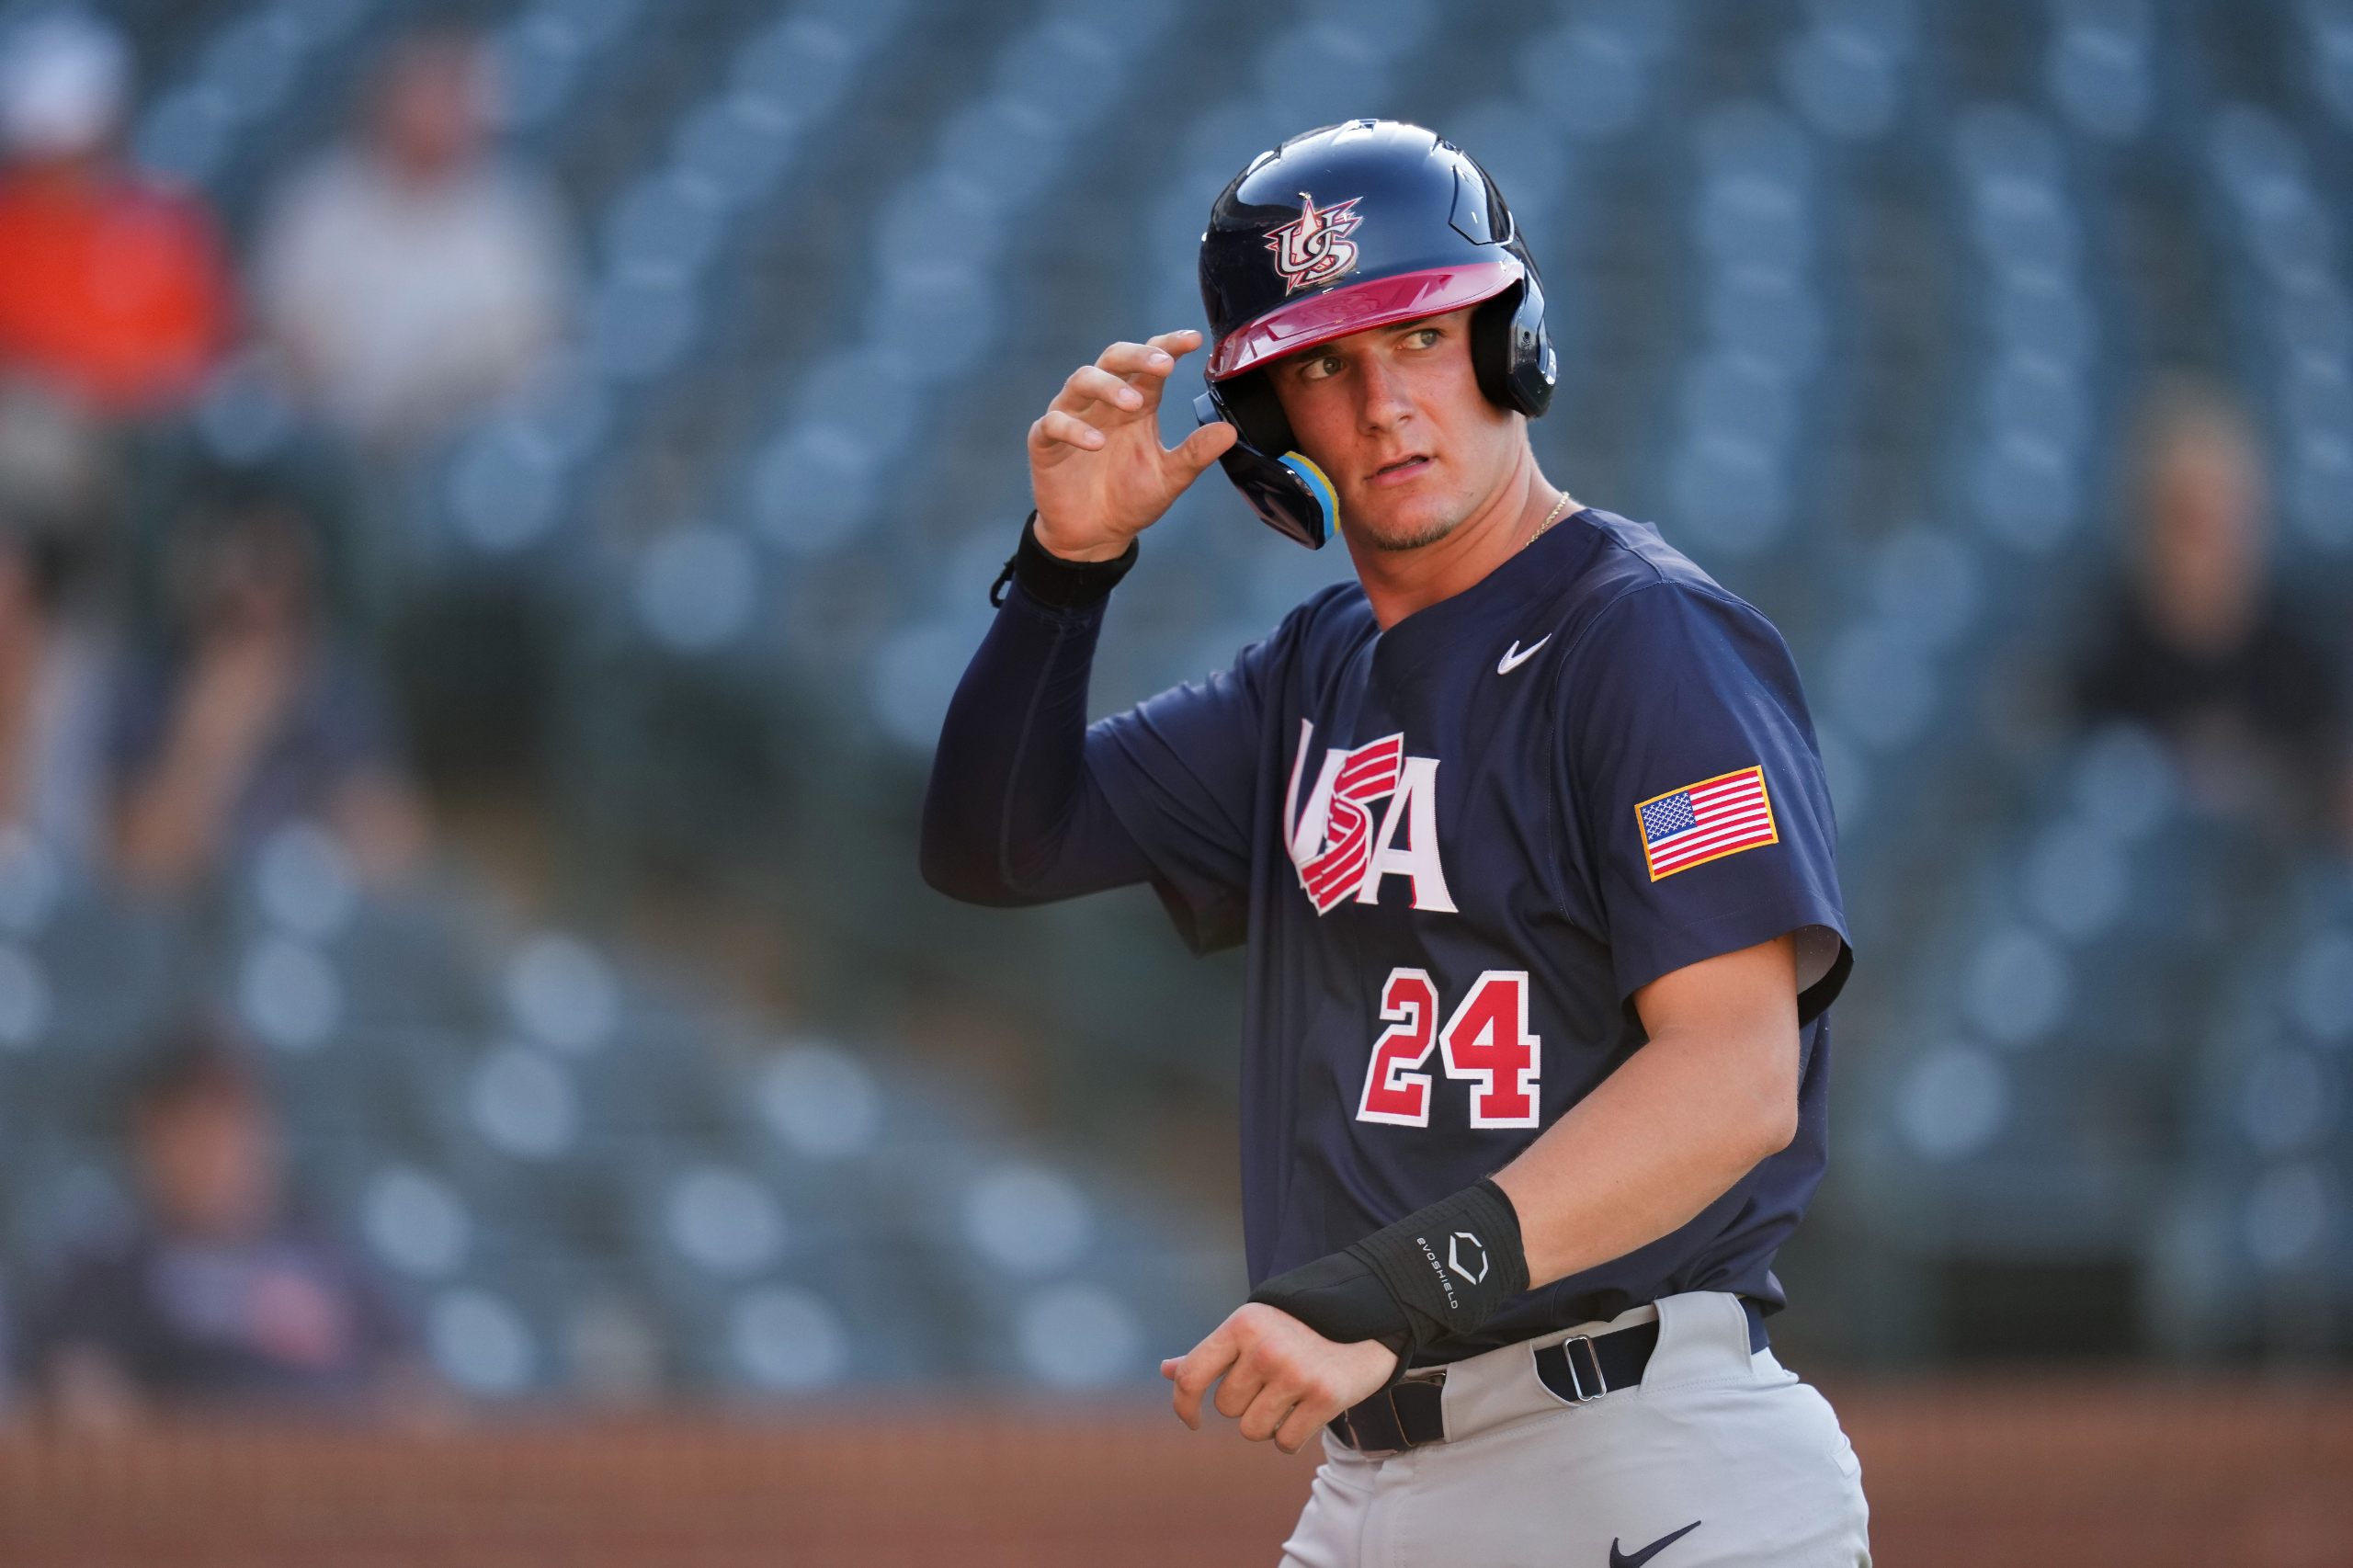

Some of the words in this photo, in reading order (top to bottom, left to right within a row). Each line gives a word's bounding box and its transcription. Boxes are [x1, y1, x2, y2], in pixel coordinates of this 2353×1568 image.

[1269, 203, 1359, 290] US
[1284, 718, 1459, 916] USA
[1356, 967, 1540, 1129] 24
